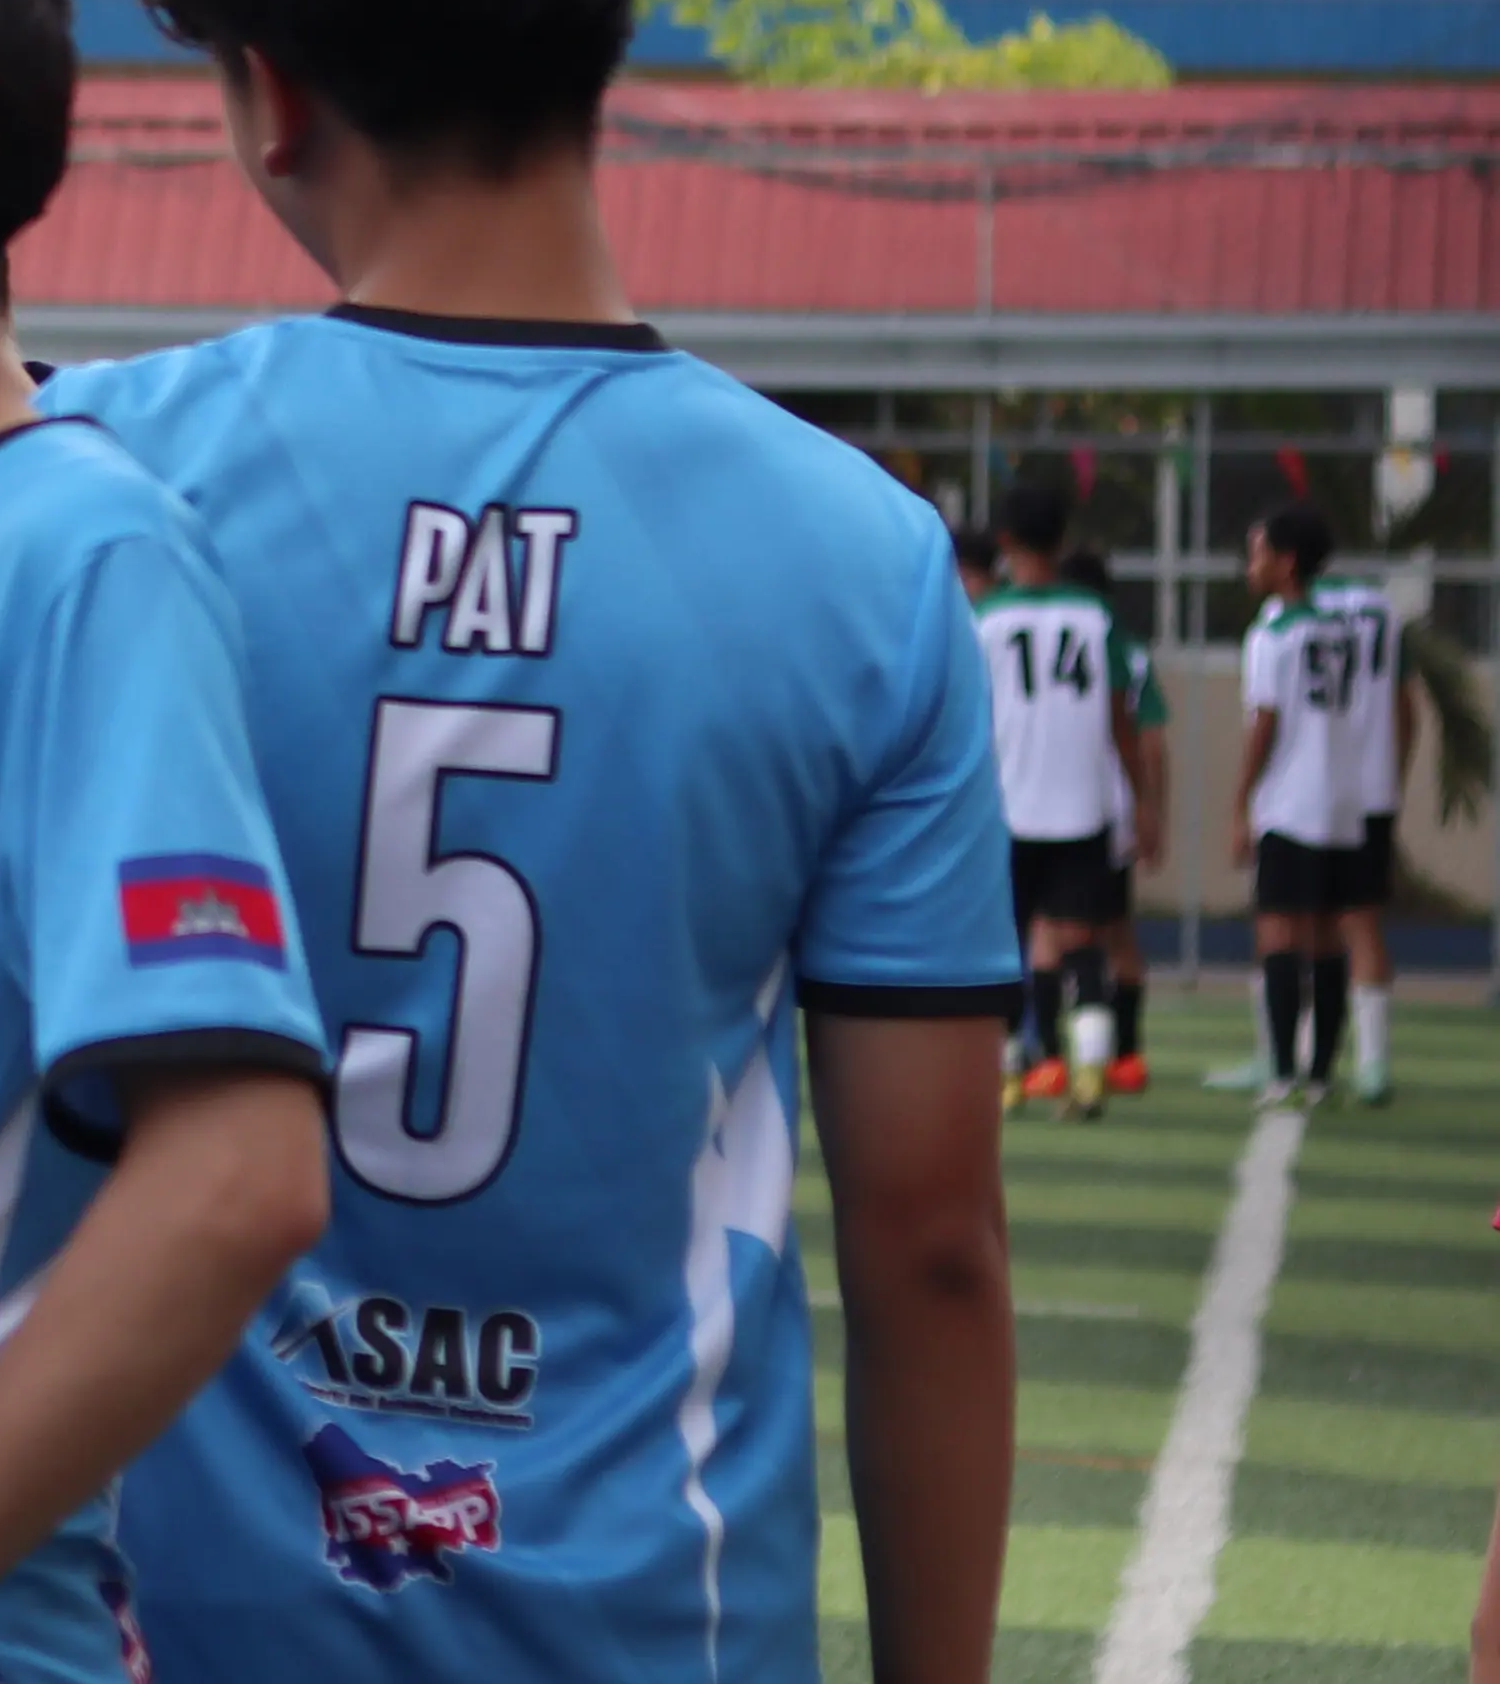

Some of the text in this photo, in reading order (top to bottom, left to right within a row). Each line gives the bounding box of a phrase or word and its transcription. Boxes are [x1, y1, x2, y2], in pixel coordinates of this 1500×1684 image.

[390, 499, 576, 656] PAT
[1007, 626, 1090, 699] 14
[334, 696, 560, 1206] 5
